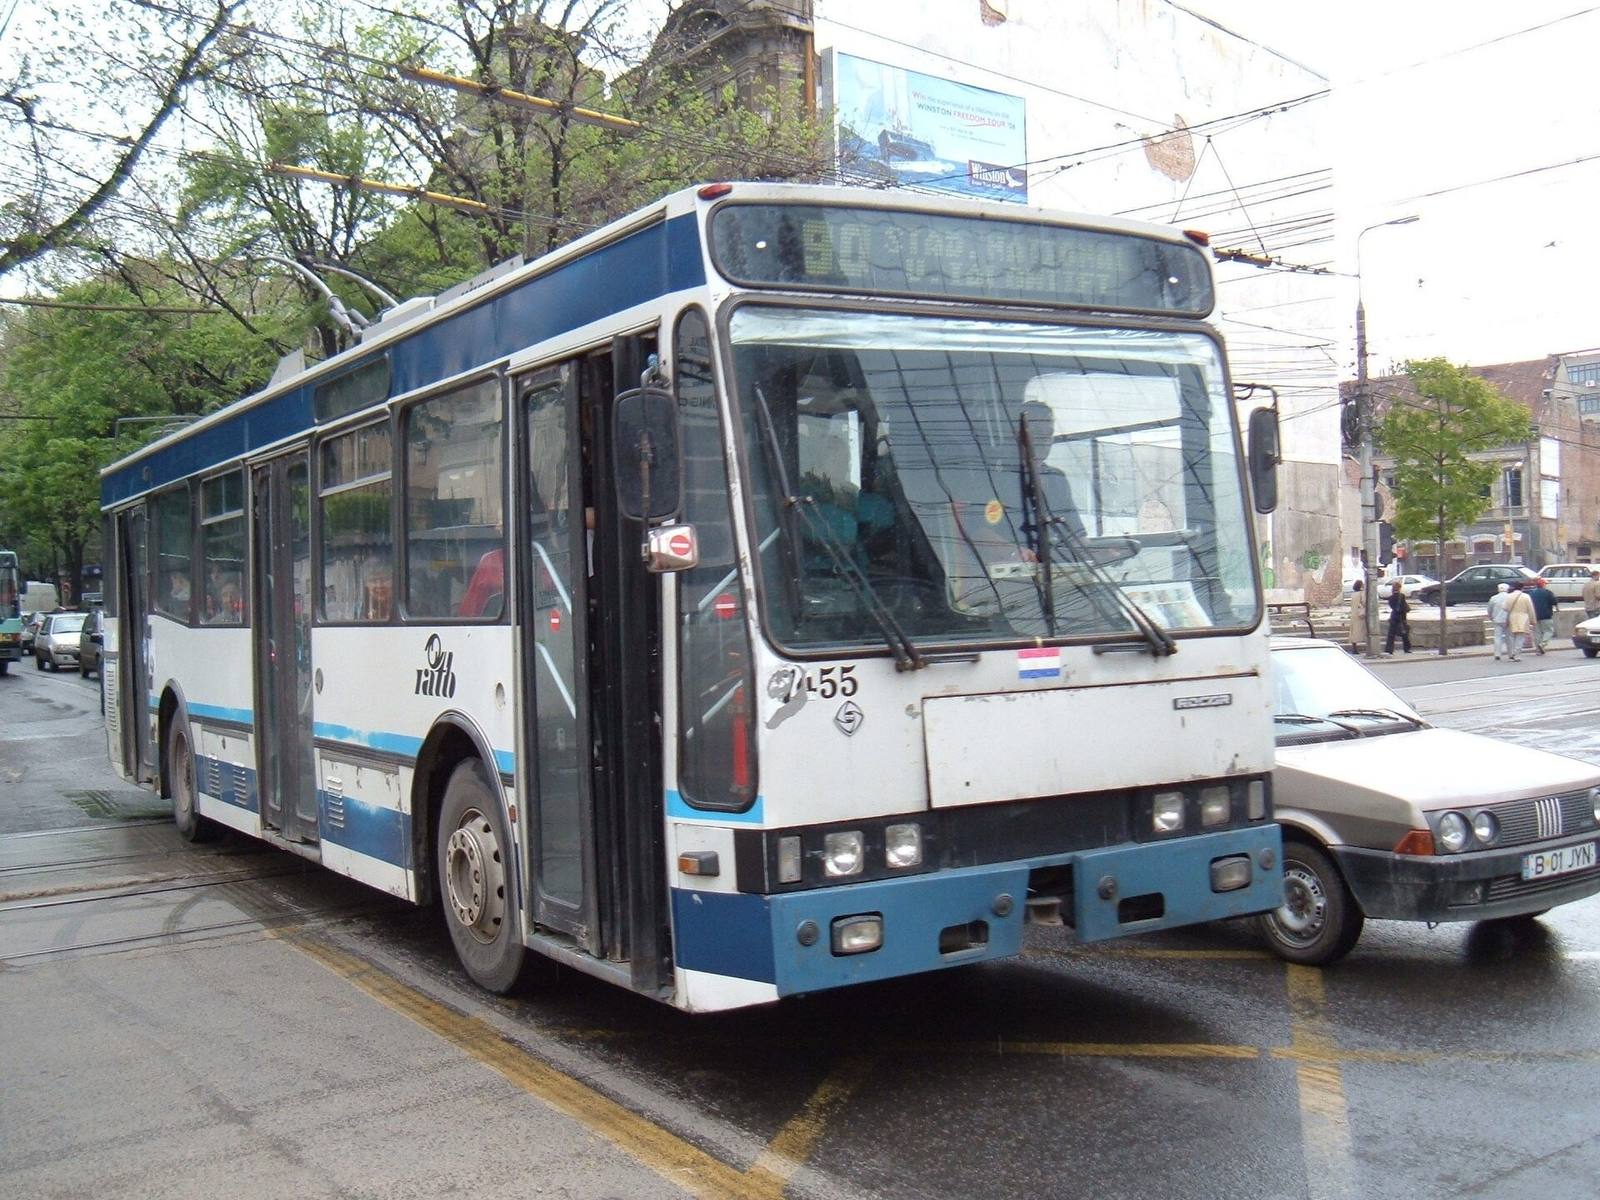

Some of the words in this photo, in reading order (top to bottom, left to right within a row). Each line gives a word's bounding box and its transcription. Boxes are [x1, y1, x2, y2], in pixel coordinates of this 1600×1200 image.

[916, 102, 952, 116] WINSTON
[987, 117, 1005, 127] TOUR
[971, 162, 1006, 184] Winston
[1535, 855, 1545, 875] B
[1551, 852, 1563, 871] 01
[1568, 845, 1591, 868] JYN
